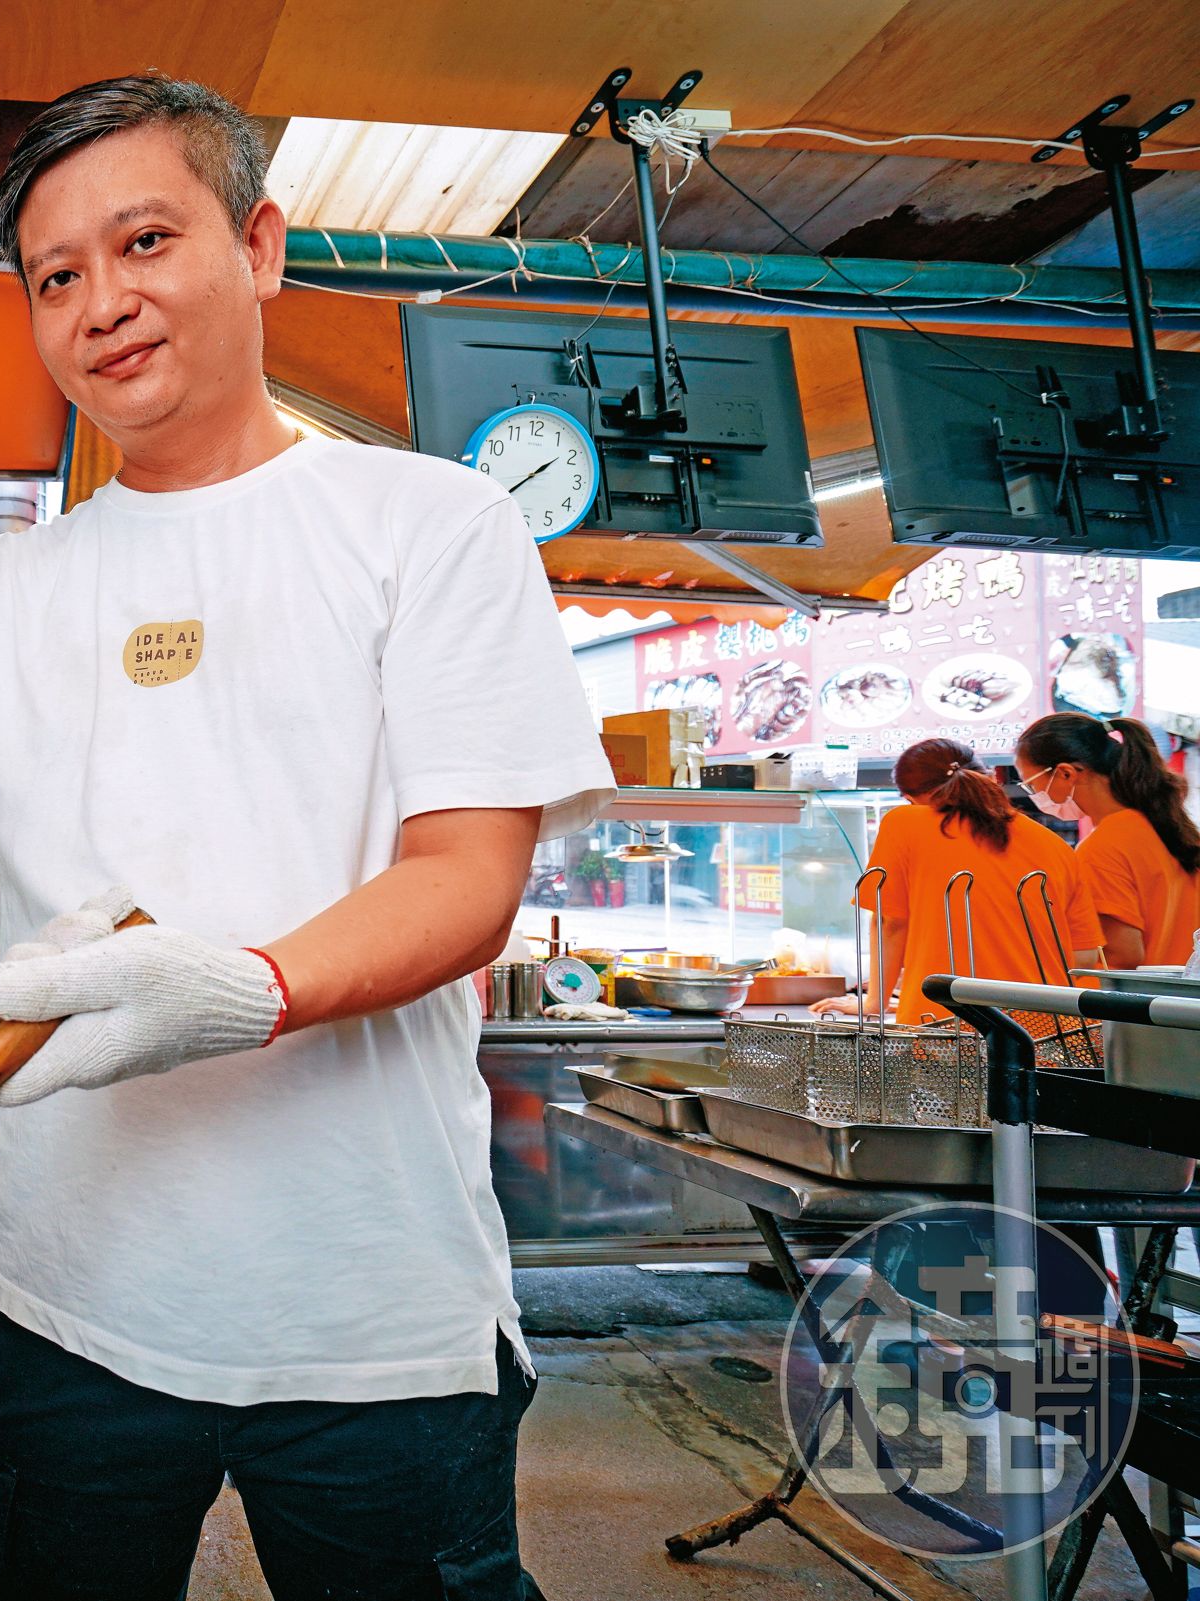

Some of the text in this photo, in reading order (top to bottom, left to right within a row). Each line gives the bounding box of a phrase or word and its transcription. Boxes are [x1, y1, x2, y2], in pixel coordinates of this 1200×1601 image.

[508, 425, 521, 442] 11
[529, 420, 545, 437] 12
[488, 439, 504, 456] 10
[554, 431, 561, 447] 1
[566, 449, 577, 466] 2
[480, 462, 490, 475] 9
[572, 474, 582, 491] 3
[561, 497, 572, 512] 4
[543, 510, 553, 527] 5
[845, 614, 996, 654] 一鴨二吃
